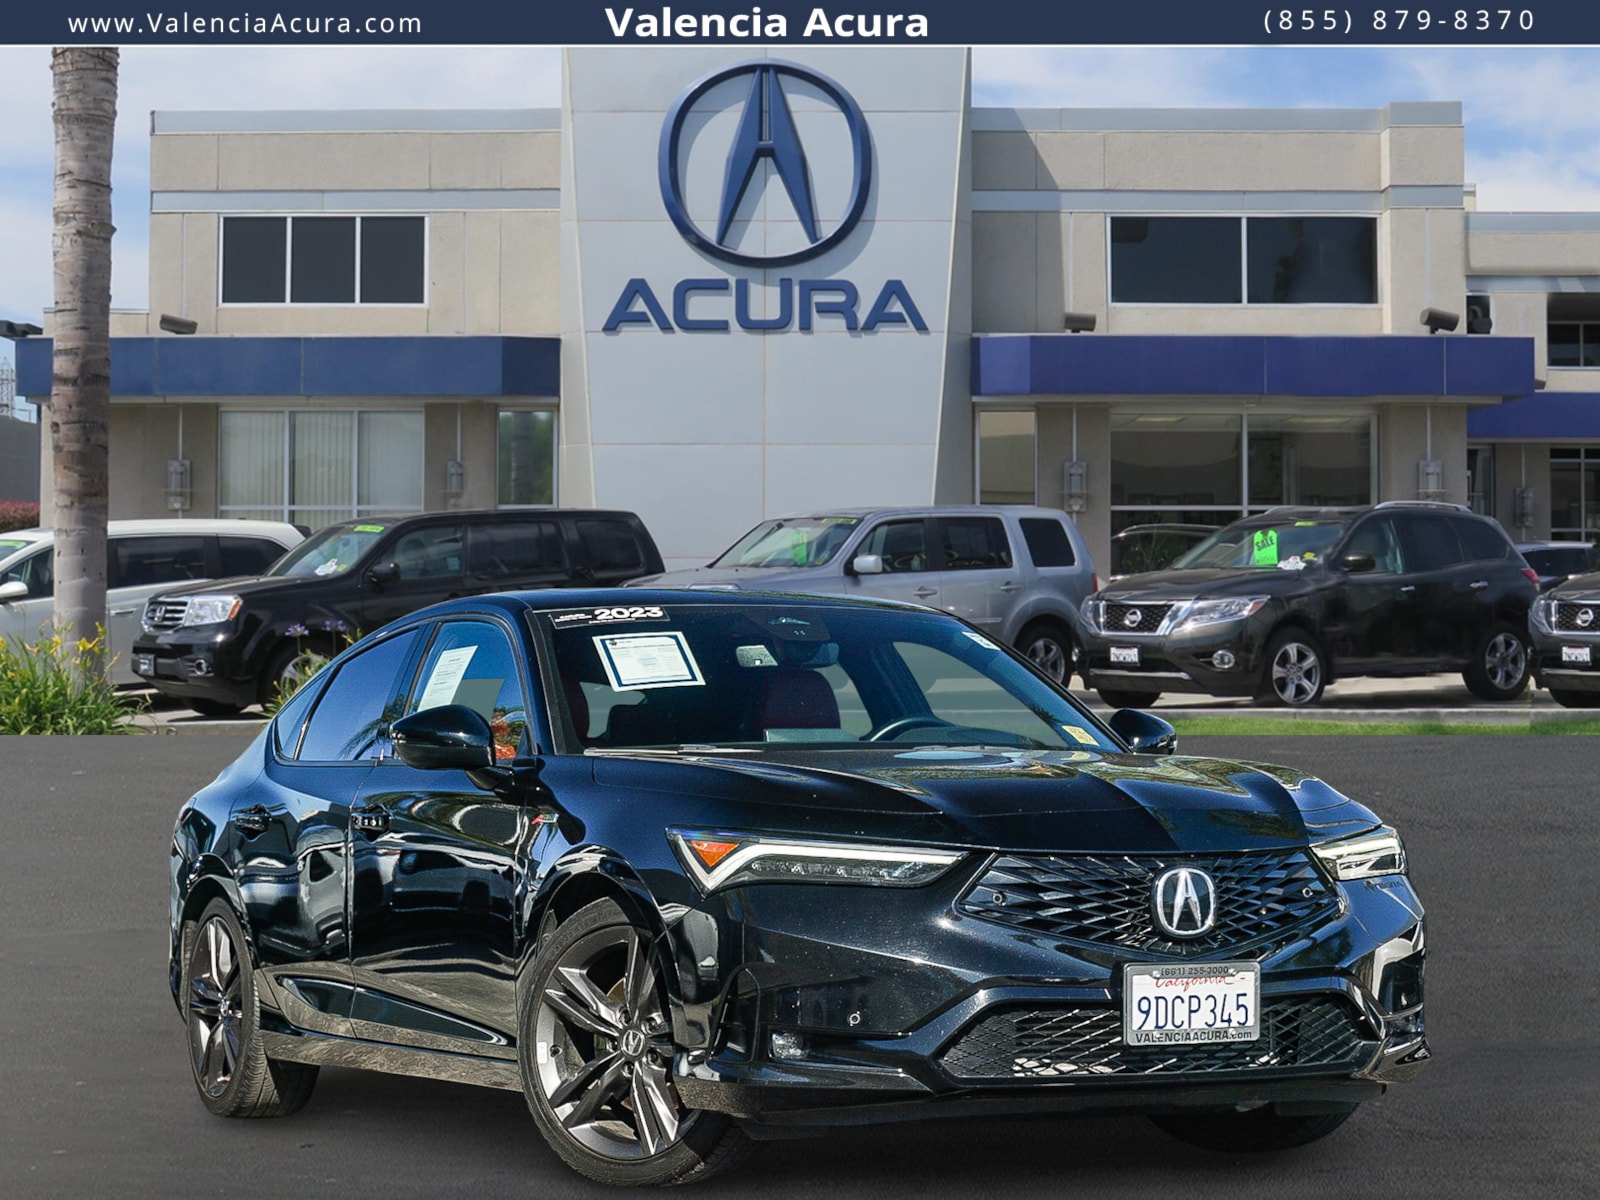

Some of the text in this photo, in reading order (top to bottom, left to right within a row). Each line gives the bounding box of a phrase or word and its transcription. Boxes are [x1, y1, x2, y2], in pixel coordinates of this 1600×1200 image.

[602, 278, 929, 335] ACURA
[1255, 536, 1275, 551] SALE
[594, 606, 664, 620] 2023
[1161, 966, 1229, 977] (661) 255-3000
[1137, 993, 1249, 1030] 9DCP345
